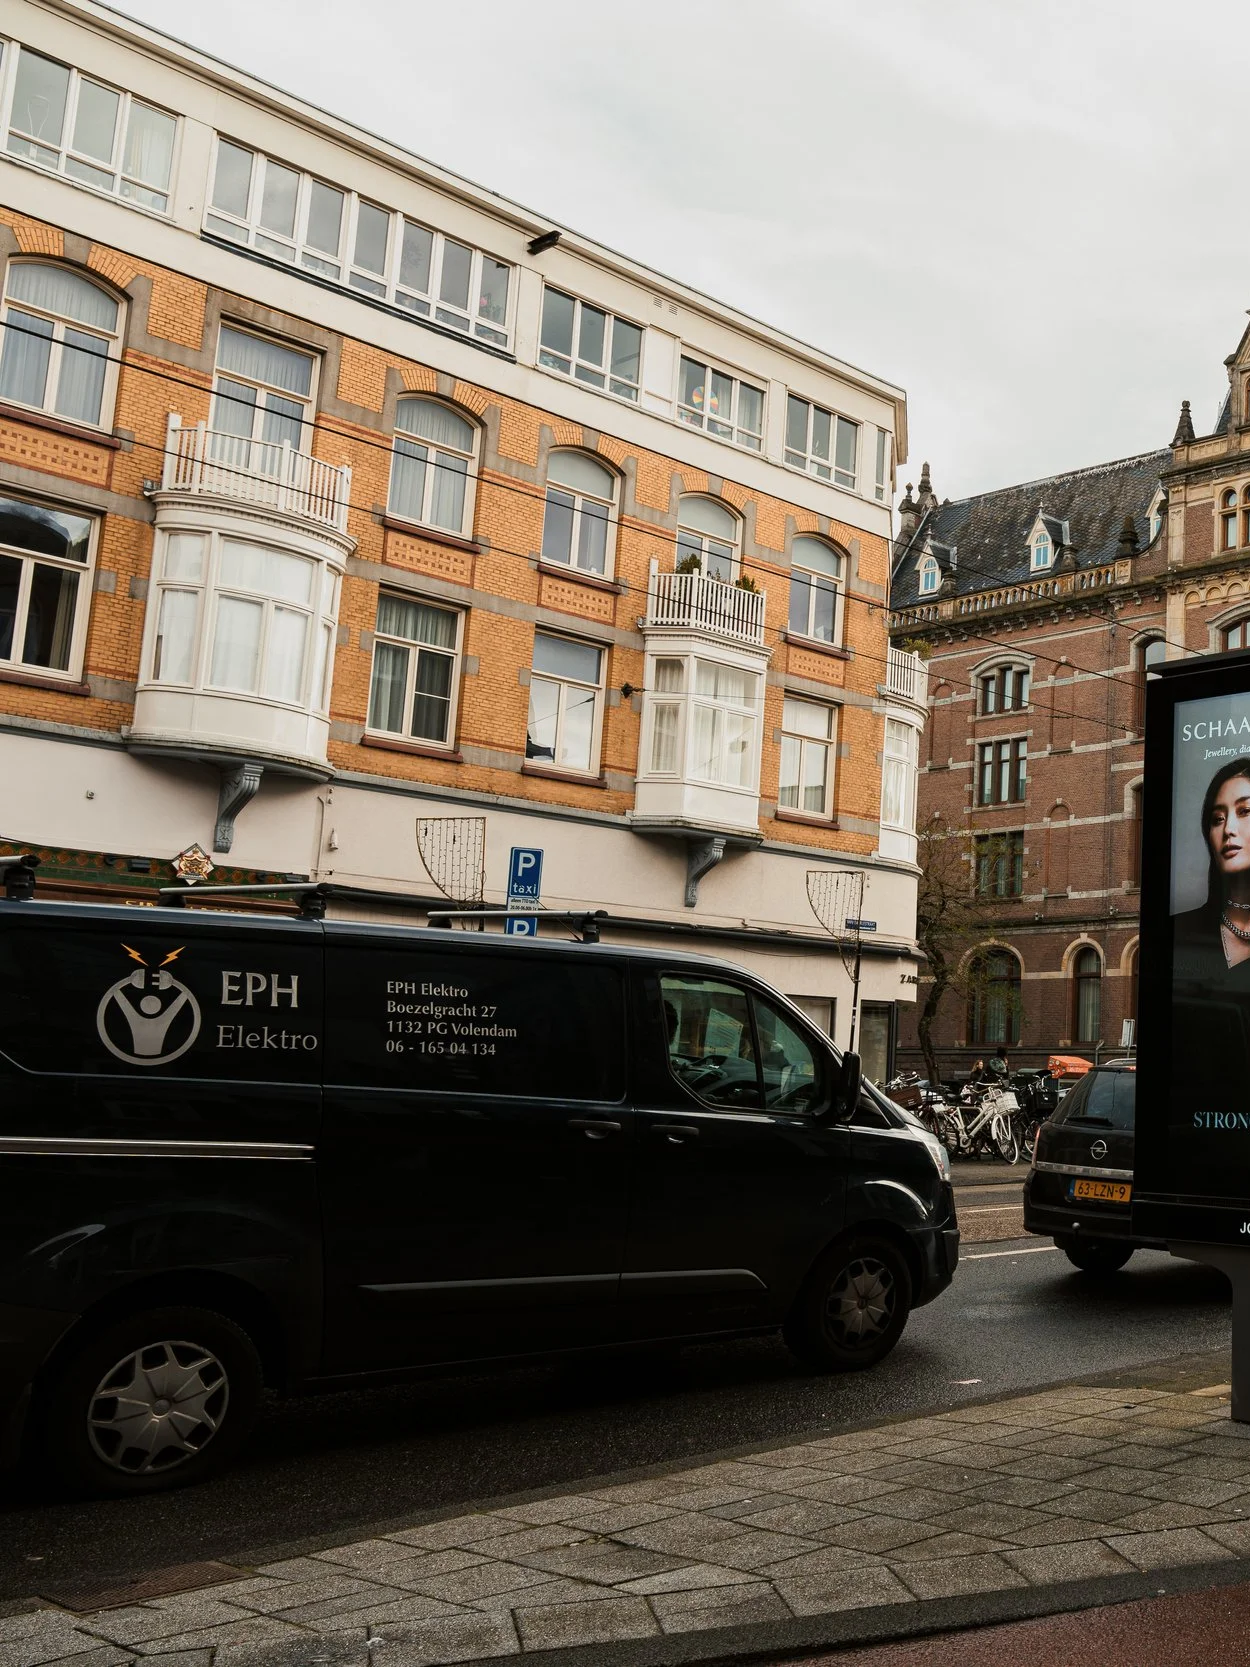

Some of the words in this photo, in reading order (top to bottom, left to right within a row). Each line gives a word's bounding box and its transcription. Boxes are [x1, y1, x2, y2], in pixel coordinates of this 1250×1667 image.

[1203, 746, 1238, 760] Jewellery,
[517, 852, 536, 877] P
[513, 882, 537, 894] taxi
[221, 970, 299, 1008] EPH
[387, 980, 416, 995] EPH
[421, 982, 469, 998] Elektro
[387, 1000, 477, 1019] Boezelgracht
[480, 1005, 497, 1018] 27
[216, 1024, 318, 1051] Elektro
[387, 1020, 422, 1034] 1132
[427, 1021, 448, 1035] PG
[451, 1022, 517, 1038] Volendam
[386, 1039, 405, 1053] 06
[419, 1041, 445, 1054] 165
[450, 1042, 467, 1055] 04
[471, 1043, 496, 1055] 134
[1077, 1182, 1126, 1200] 63-LZN-9
